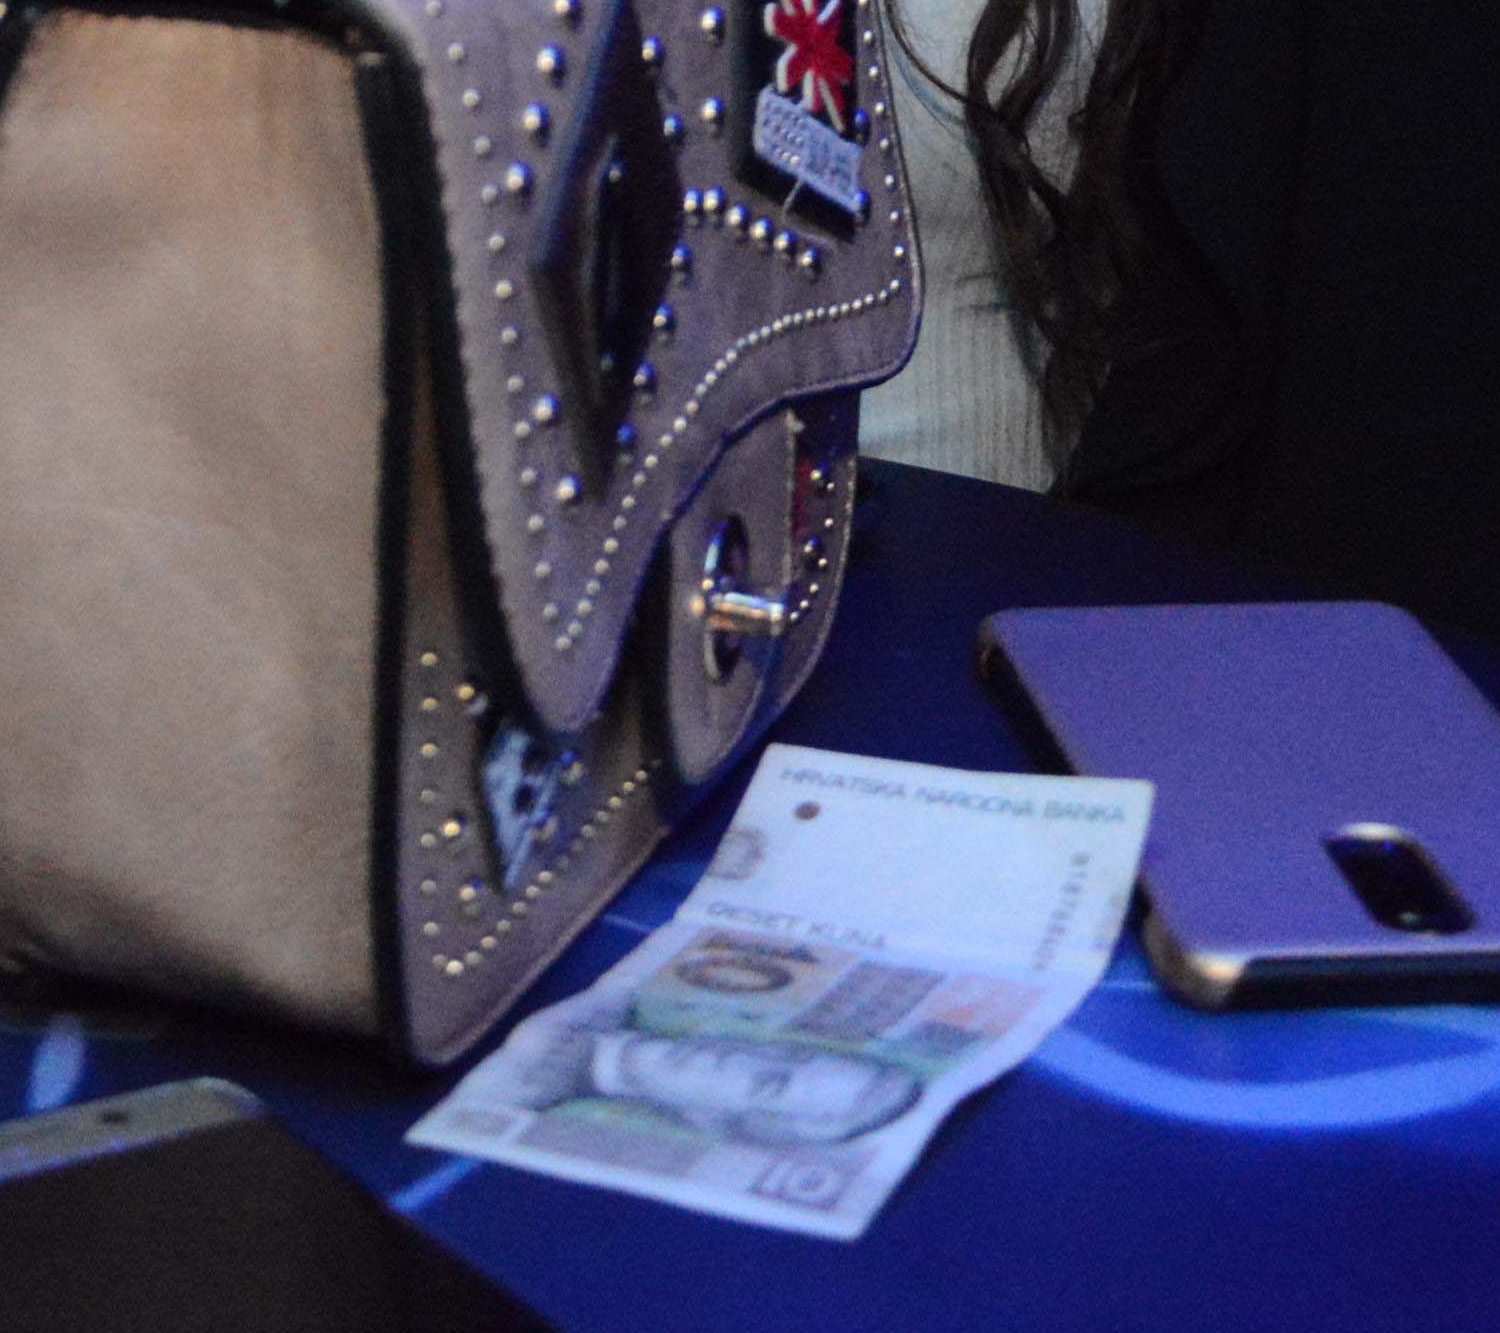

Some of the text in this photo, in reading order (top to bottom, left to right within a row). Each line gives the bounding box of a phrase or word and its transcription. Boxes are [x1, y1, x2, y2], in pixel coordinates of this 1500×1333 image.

[781, 767, 1125, 824] HRVATSKA NARODNA BANKA
[757, 1159, 843, 1206] 10
